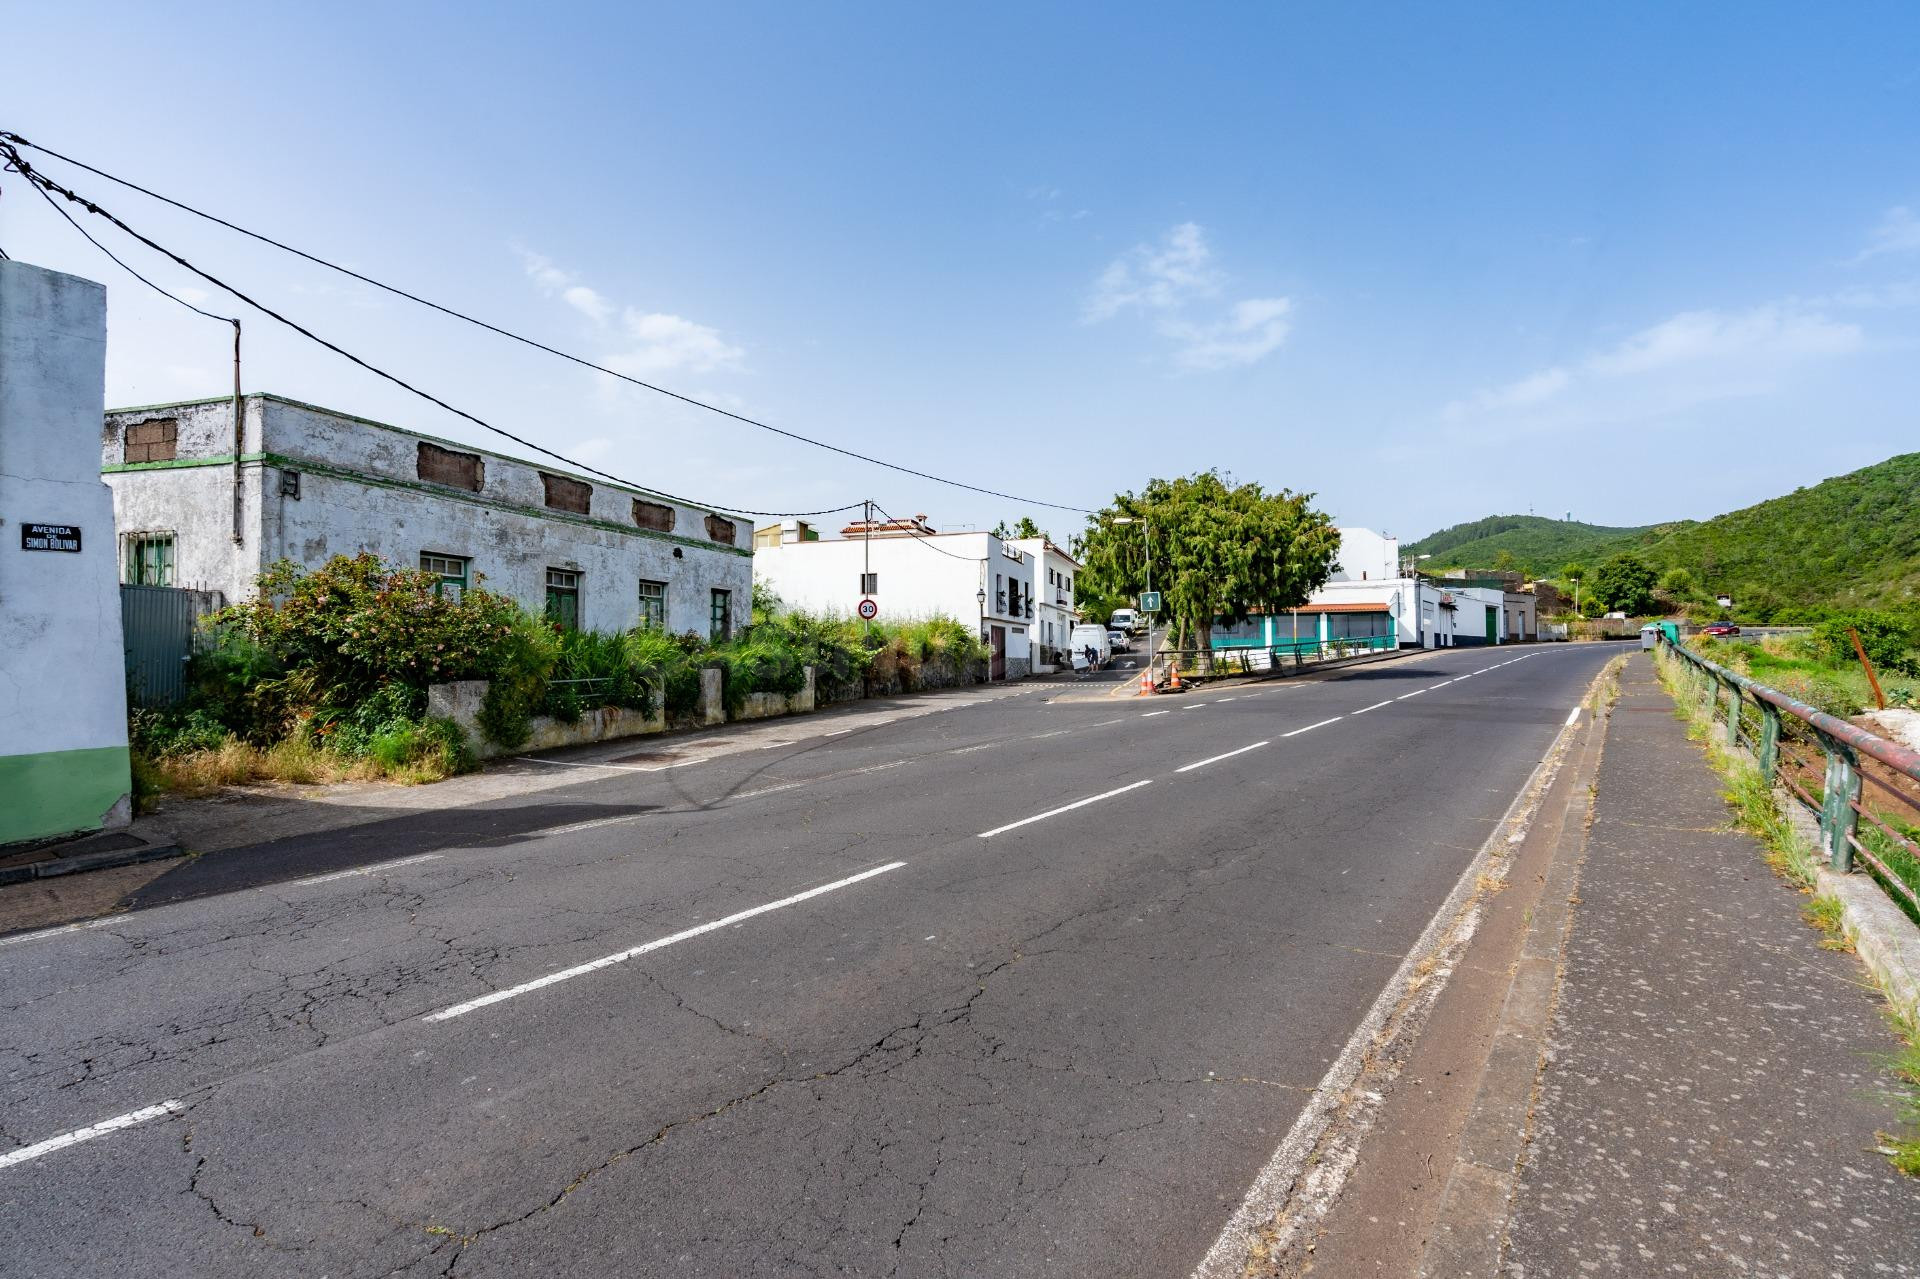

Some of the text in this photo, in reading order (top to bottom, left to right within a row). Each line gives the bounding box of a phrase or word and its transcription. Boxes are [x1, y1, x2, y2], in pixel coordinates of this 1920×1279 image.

[31, 526, 72, 535] AVENIDA
[26, 537, 78, 551] SIMON BOLIVAR
[862, 605, 874, 613] 30
